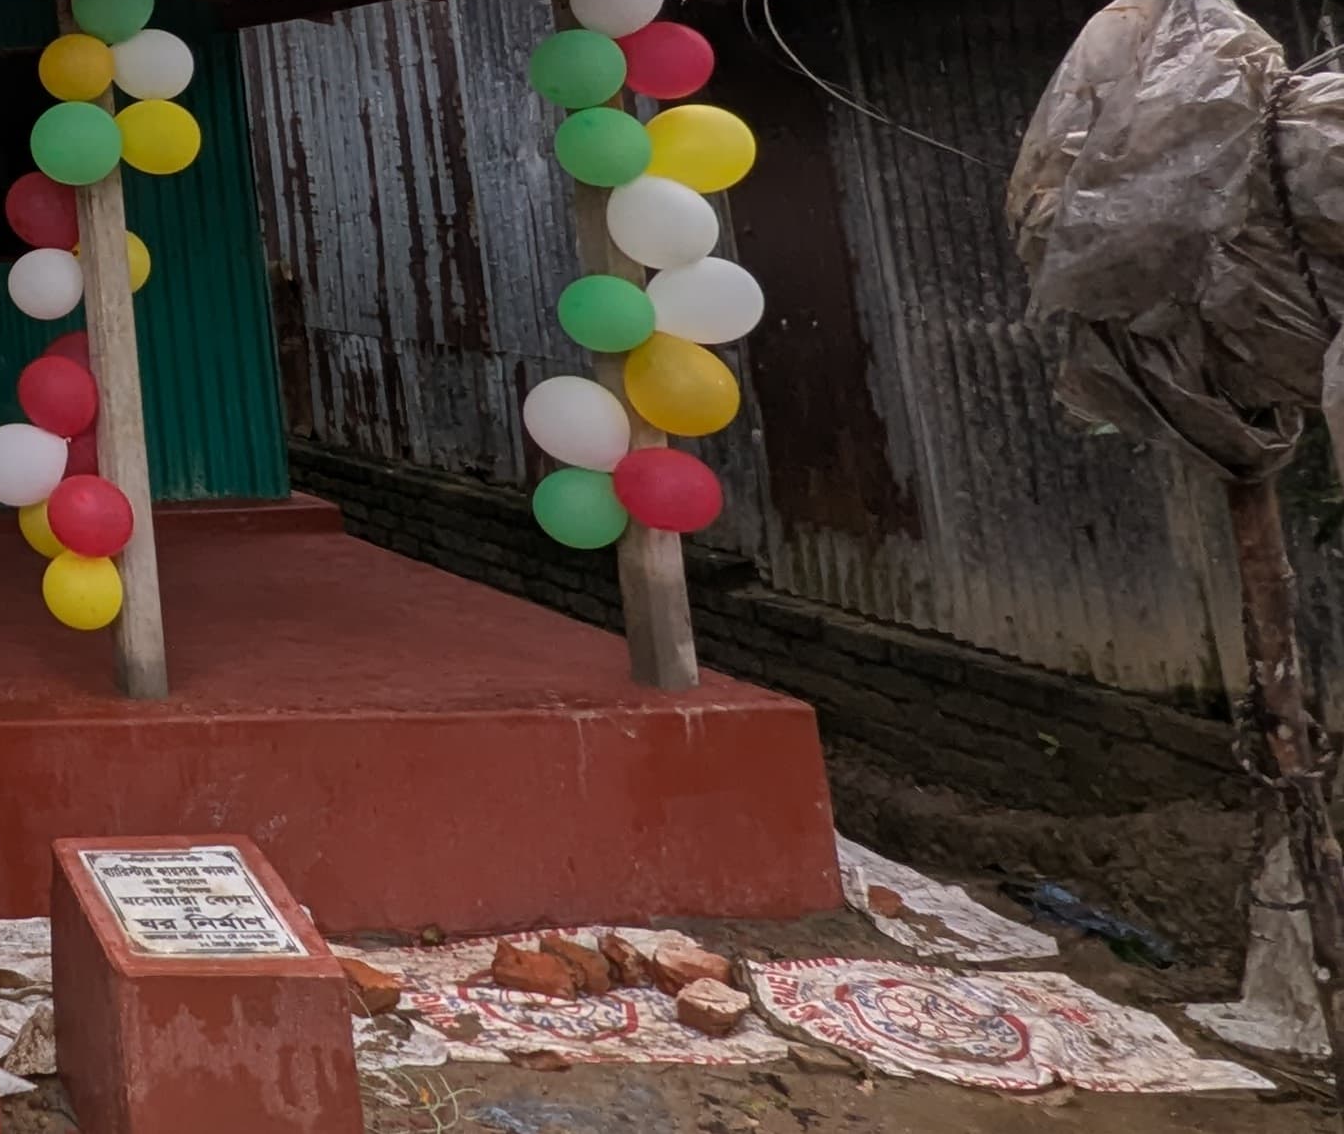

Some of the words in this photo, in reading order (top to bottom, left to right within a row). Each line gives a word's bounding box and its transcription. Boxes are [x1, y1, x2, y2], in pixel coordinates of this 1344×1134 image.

[120, 895, 198, 906] মনোয়ারা
[205, 895, 254, 906] বেগম
[135, 918, 178, 930] ঘর
[184, 913, 266, 930] নির্মাণ
